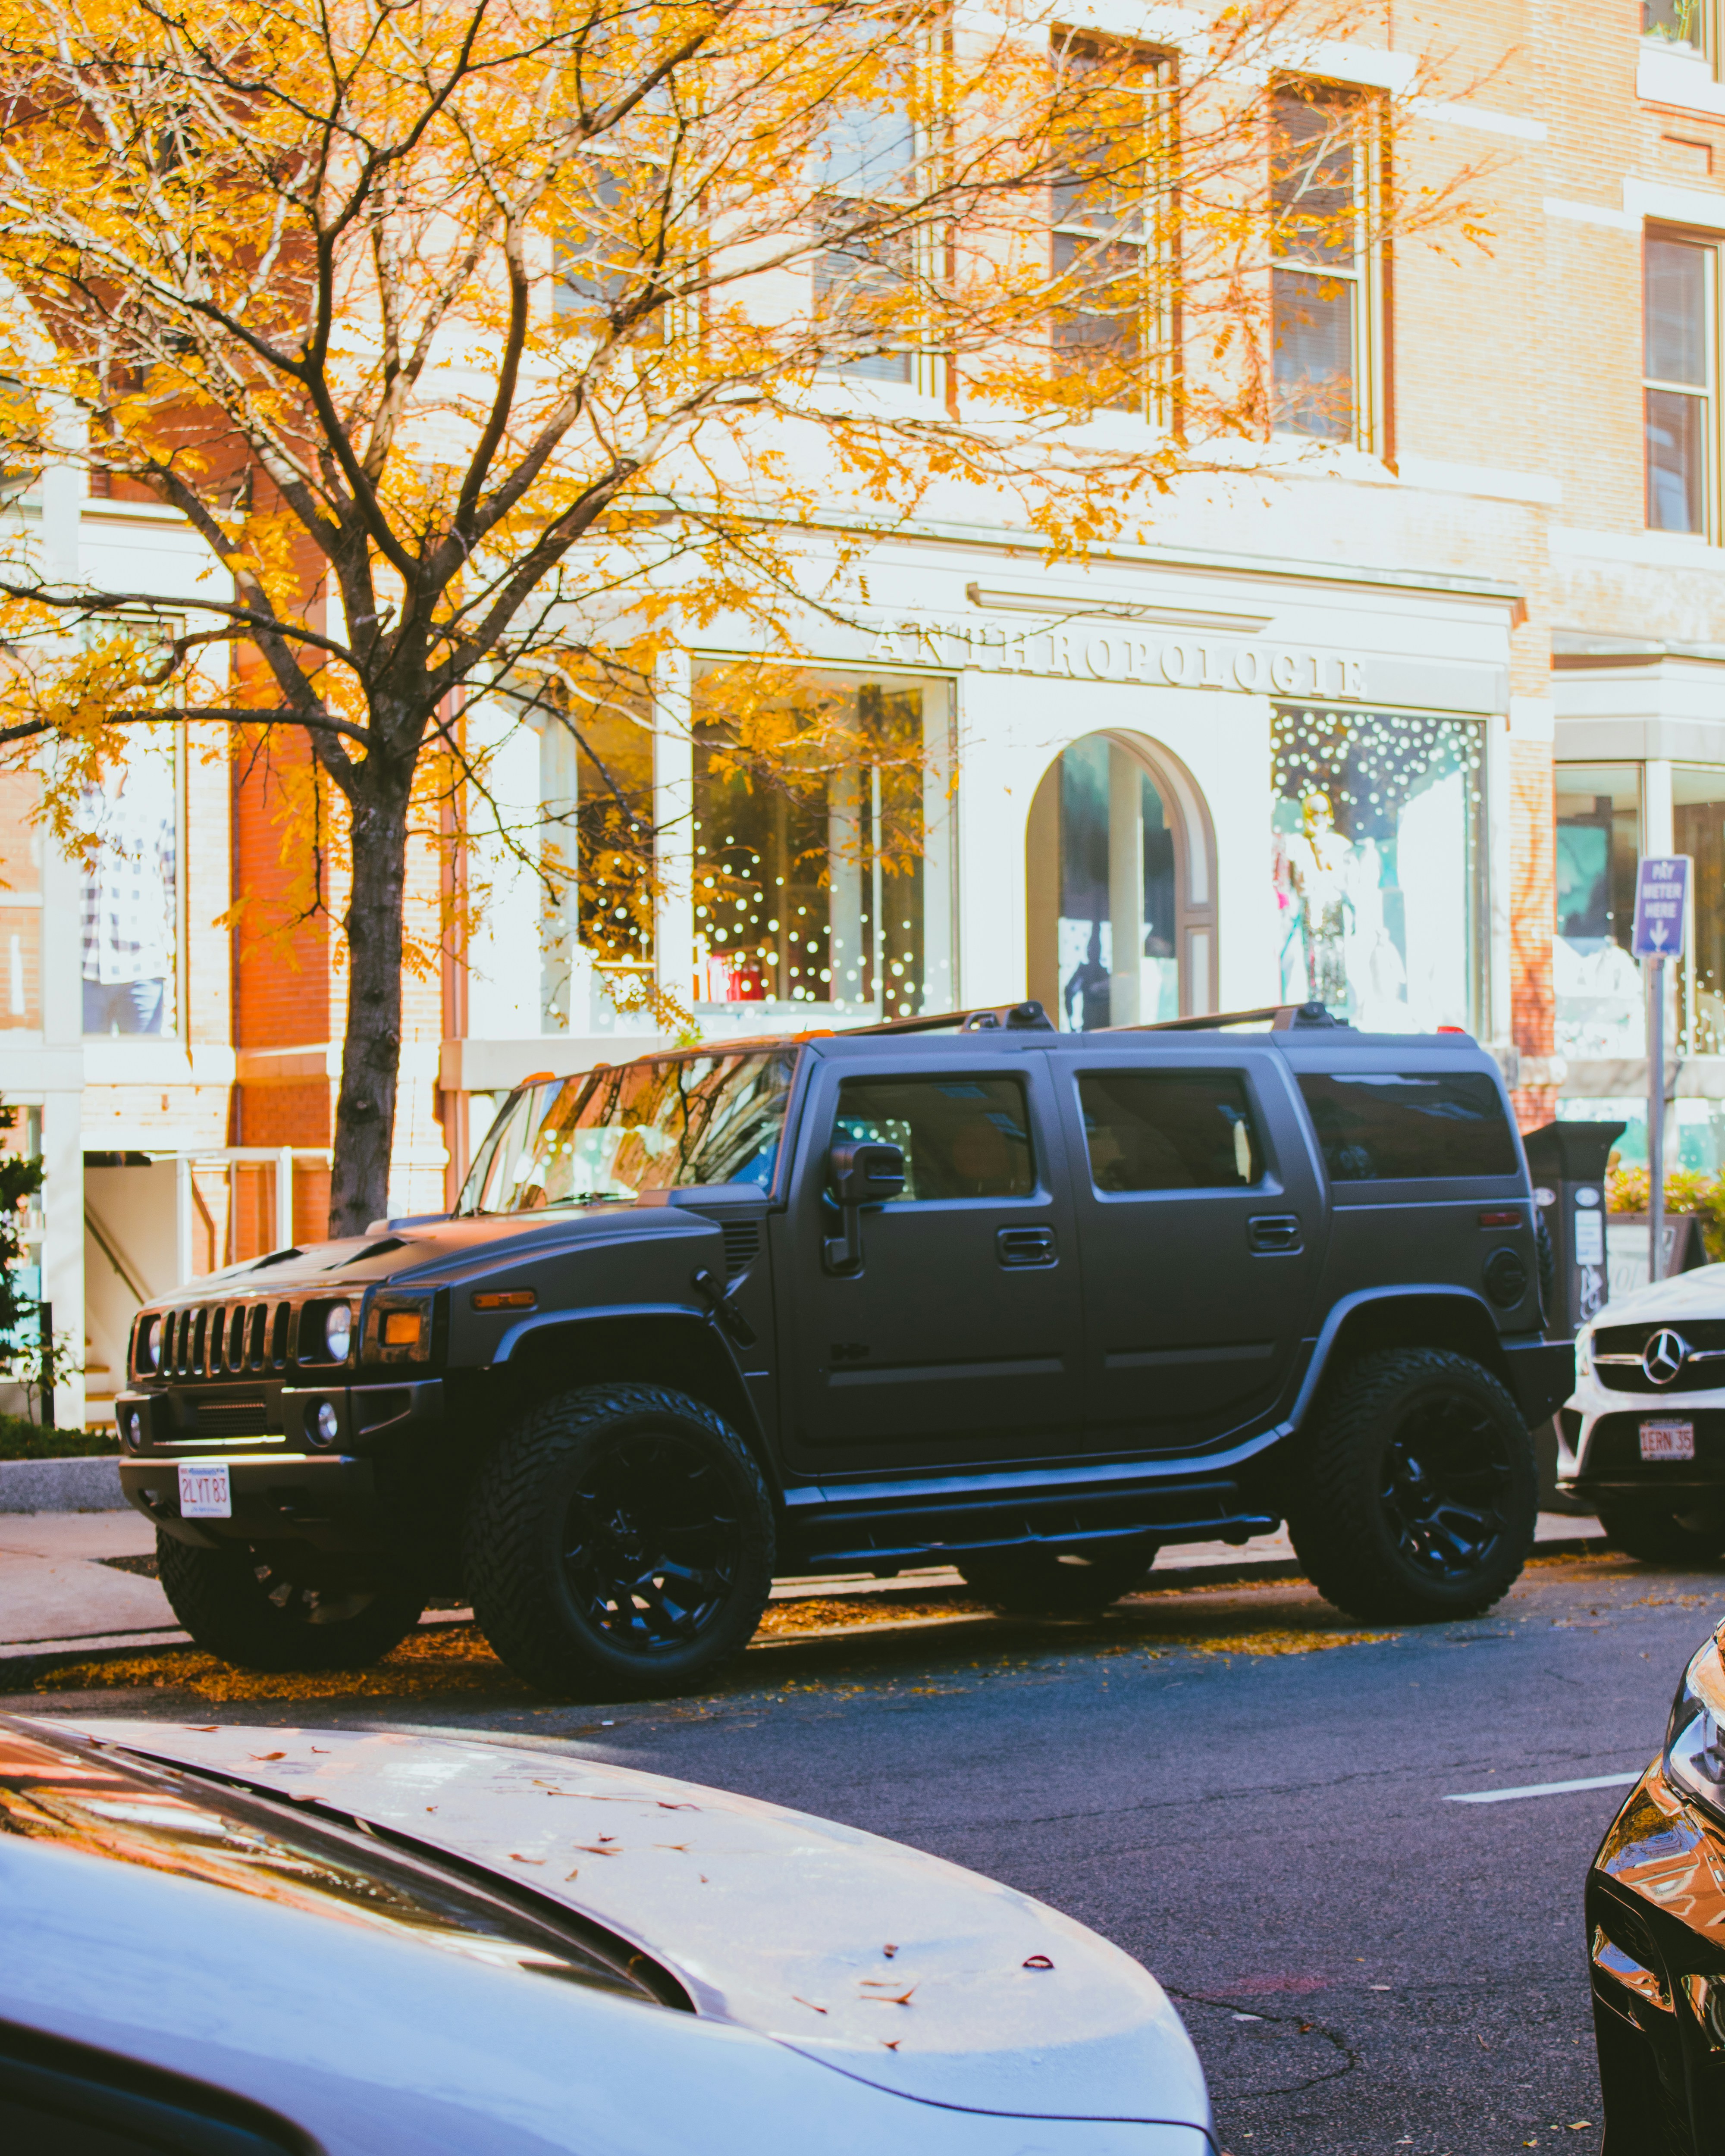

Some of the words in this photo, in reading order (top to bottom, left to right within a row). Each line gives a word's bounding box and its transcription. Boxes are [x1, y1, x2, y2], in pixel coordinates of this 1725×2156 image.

[867, 617, 1368, 700] ANTHROPOLOGIE
[1652, 864, 1675, 880] PAY
[1642, 883, 1681, 899] METER
[1645, 902, 1677, 918] HERE
[1641, 1431, 1672, 1451] 1ERN
[1675, 1430, 1691, 1450] 35
[182, 1478, 210, 1503] 2LYT
[213, 1478, 226, 1502] 83
